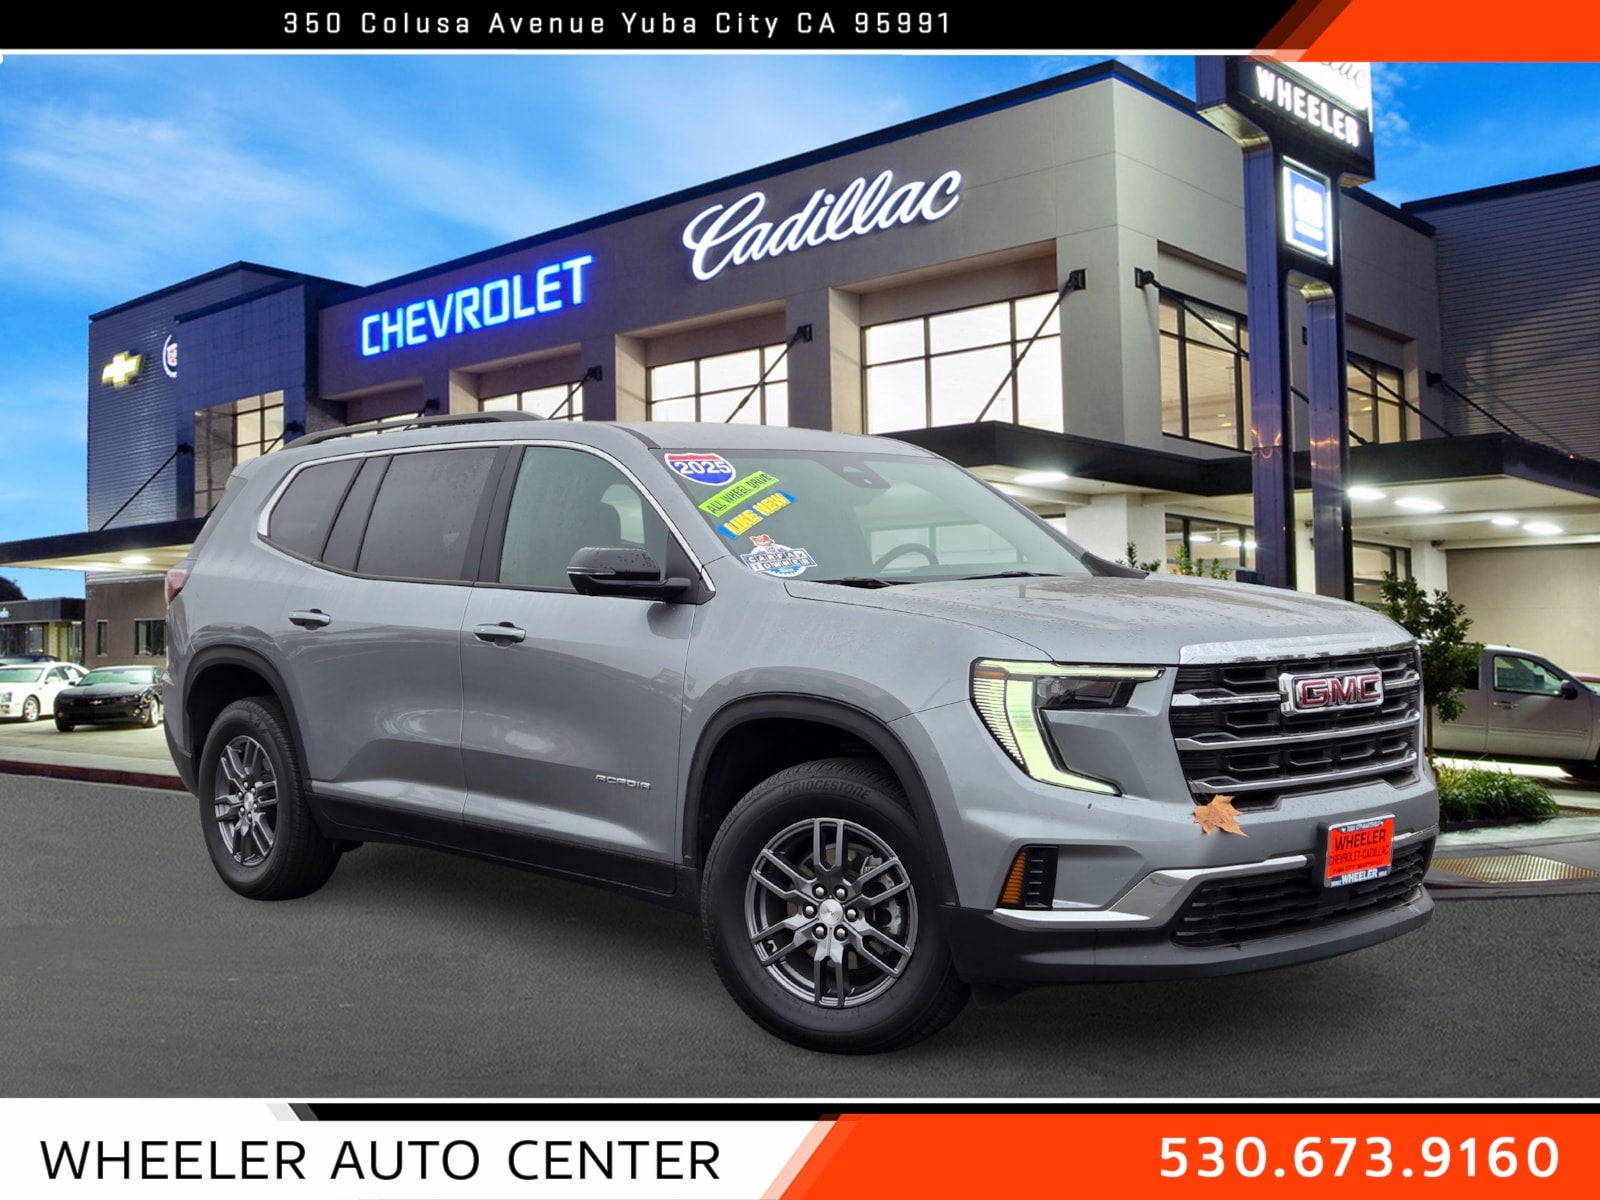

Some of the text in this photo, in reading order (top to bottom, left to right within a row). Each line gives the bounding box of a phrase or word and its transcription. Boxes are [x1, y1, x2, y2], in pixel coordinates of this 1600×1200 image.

[1255, 64, 1360, 148] WHEELER
[683, 169, 962, 281] Cadillac
[361, 255, 593, 356] CHEVROLET
[674, 460, 732, 475] 2025
[707, 473, 772, 514] ALL WHEEL DRIVE
[748, 550, 807, 563] CARFAX
[763, 558, 811, 569] OWNER
[1296, 674, 1381, 709] GMC
[595, 774, 651, 790] ACADIA
[784, 779, 872, 799] BRIDGESTONE
[1335, 829, 1386, 851] WHEELER
[1341, 868, 1378, 885] WHEELER
